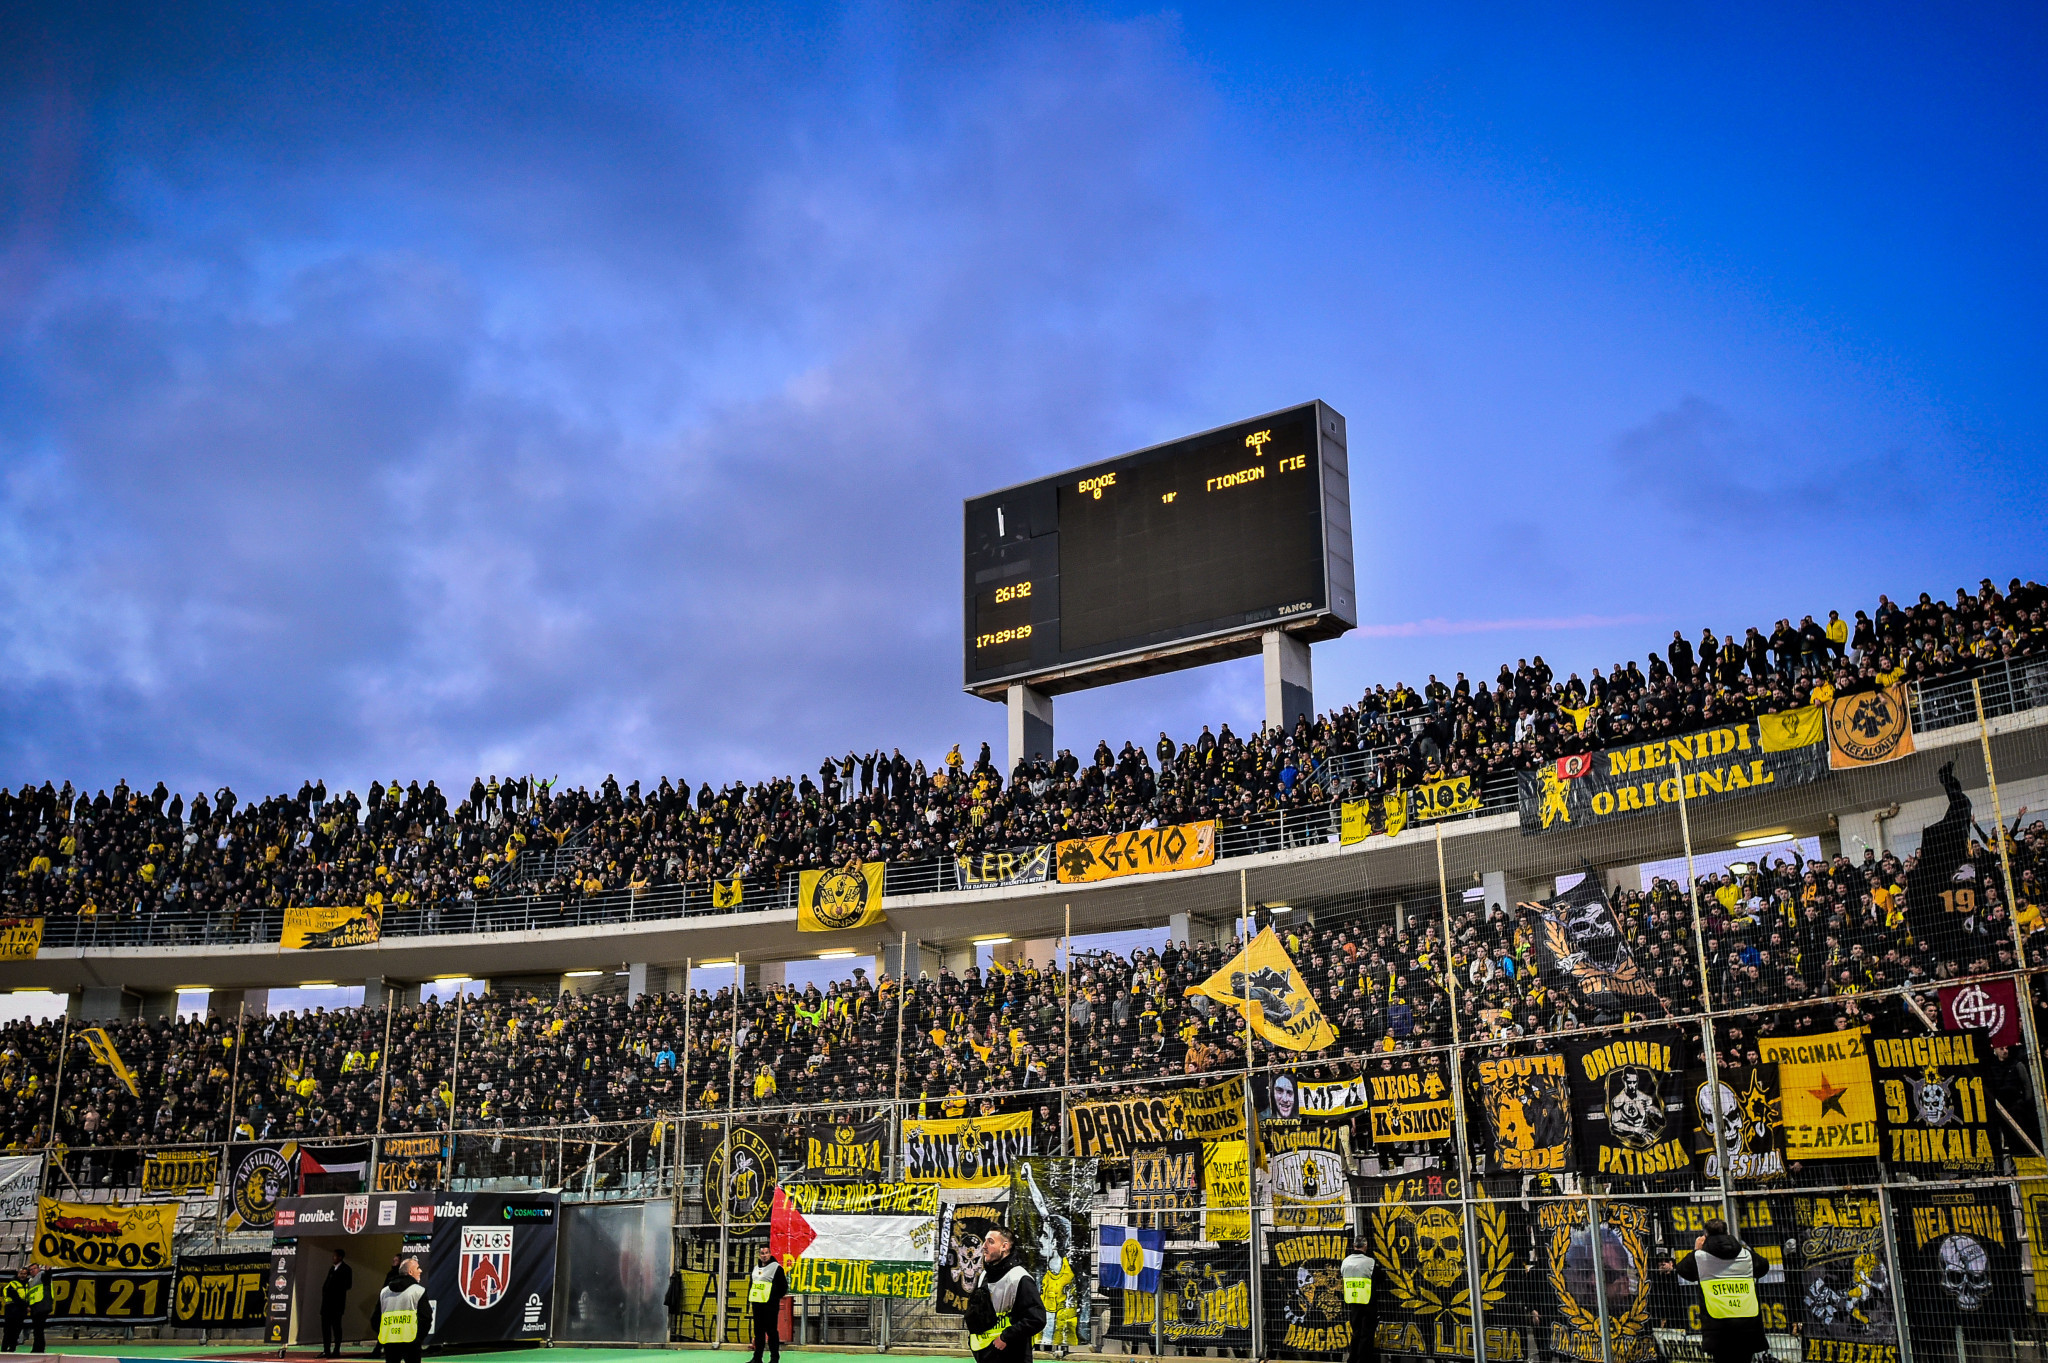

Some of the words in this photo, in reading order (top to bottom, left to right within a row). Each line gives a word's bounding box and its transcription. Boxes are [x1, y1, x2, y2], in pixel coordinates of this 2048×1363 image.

[1255, 444, 1262, 456] 1
[1280, 454, 1306, 473] ΓΙΕ
[995, 581, 1032, 603] 26:32
[976, 624, 1033, 648] 17:29:29
[1607, 723, 1752, 776] MENIDI
[1591, 760, 1774, 815] ORIGINAL
[1098, 826, 1187, 872] GETTO
[813, 904, 858, 927] ORIGINAL
[1582, 1041, 1672, 1081] ORIGINAL
[1767, 1041, 1846, 1065] ORIGINAL
[1874, 1034, 1980, 1068] ORIGINAL
[1479, 1054, 1566, 1087] SOUTH
[1370, 1073, 1421, 1100] NEOS
[1884, 1079, 1909, 1124] 9
[1955, 1076, 1988, 1123] 11
[1186, 1108, 1238, 1133] FORMS
[1271, 1126, 1321, 1154] Original
[1323, 1127, 1337, 1151] 21
[1889, 1128, 1995, 1163] TRIKALA
[238, 1151, 288, 1182] AMFILOCHIA
[807, 1137, 882, 1172] RAFINA
[1598, 1137, 1690, 1175] PATISSIA
[1132, 1152, 1198, 1192] KAMA
[299, 1209, 335, 1223] novibet
[544, 1209, 552, 1217] TV
[1420, 1214, 1454, 1229] AEK
[464, 1234, 511, 1248] VOLOS
[1912, 1207, 1950, 1251] NEA
[38, 1233, 162, 1267] OROPOS
[271, 1246, 296, 1256] novibet
[402, 1243, 430, 1253] novibet
[782, 1254, 876, 1295] PALESTINE
[106, 1280, 159, 1315] 21
[1712, 1283, 1749, 1296] STEWARD
[383, 1315, 412, 1326] STEWARD
[522, 1323, 547, 1332] Admiral
[1806, 1338, 1898, 1363] ATHENS
